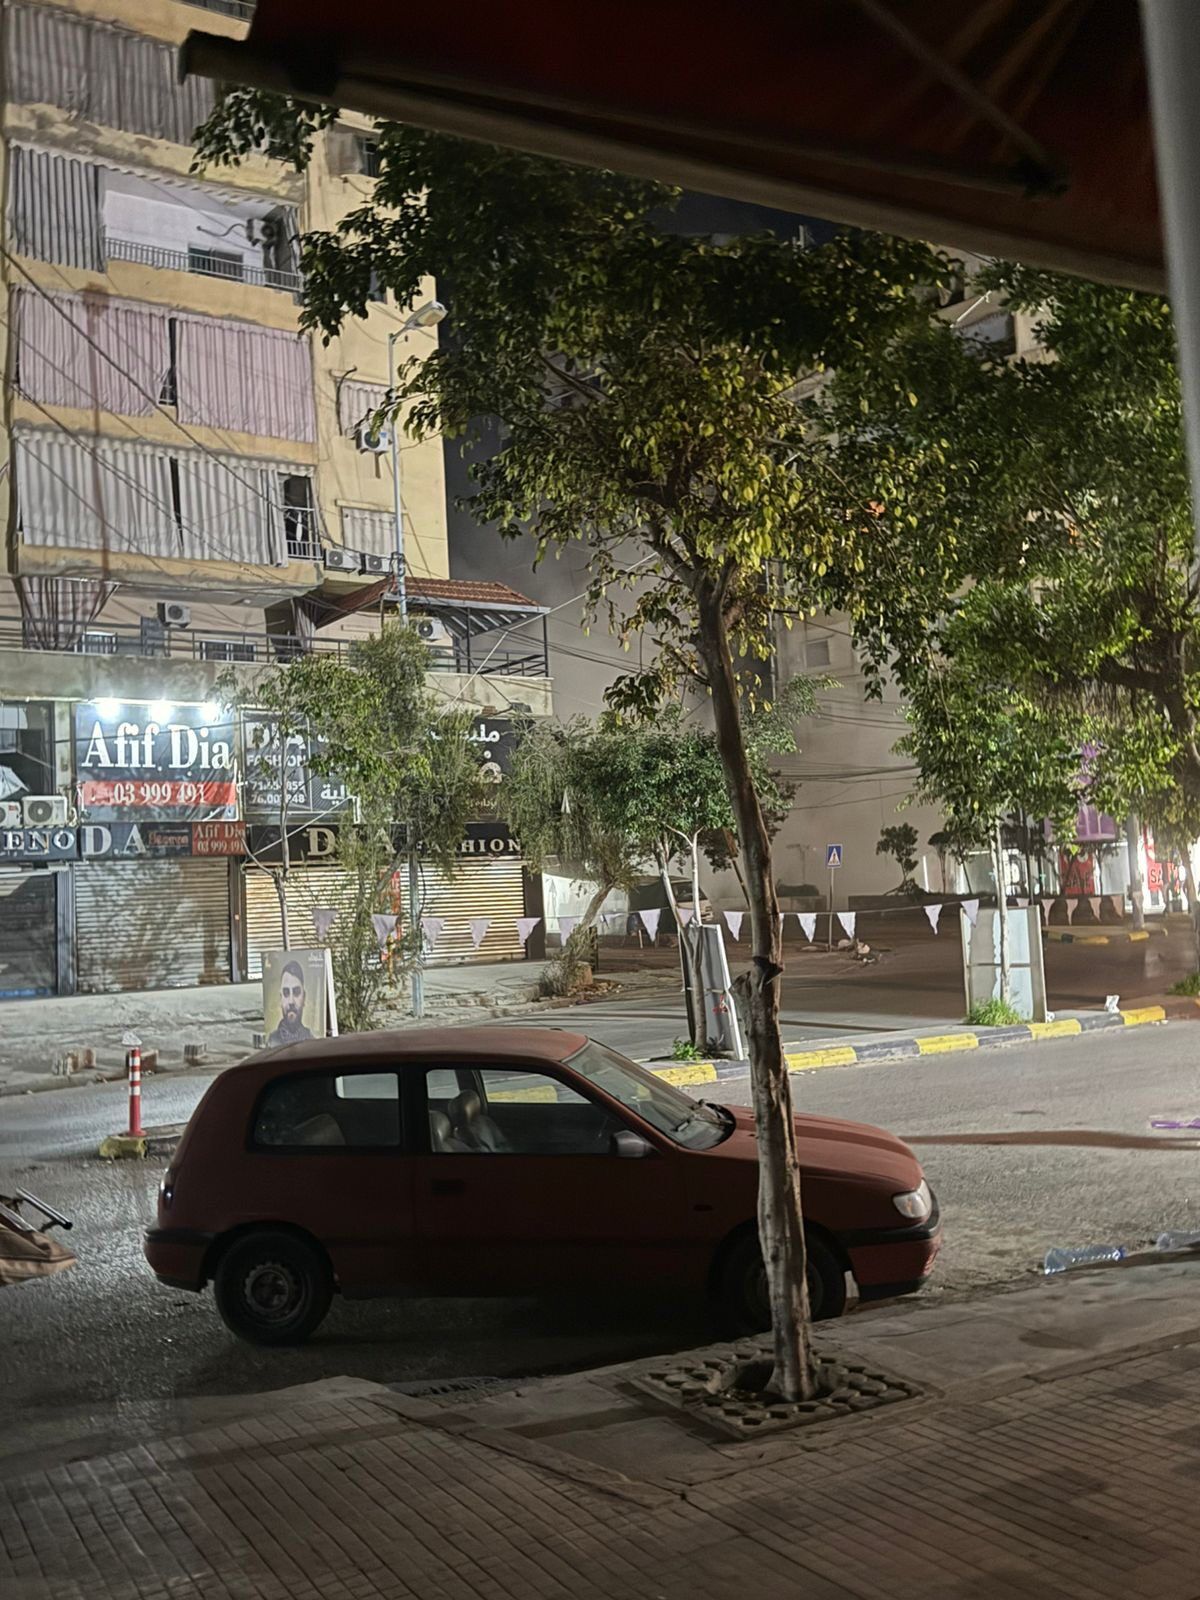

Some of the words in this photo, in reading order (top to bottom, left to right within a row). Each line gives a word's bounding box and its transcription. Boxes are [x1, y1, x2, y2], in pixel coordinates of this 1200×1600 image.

[81, 720, 160, 769] Afif
[167, 724, 233, 769] Dia
[246, 754, 307, 767] FASHON
[113, 783, 135, 804] 03
[140, 783, 171, 804] 999
[82, 824, 147, 856] D.A
[210, 840, 228, 853] 999
[306, 828, 397, 856] DA
